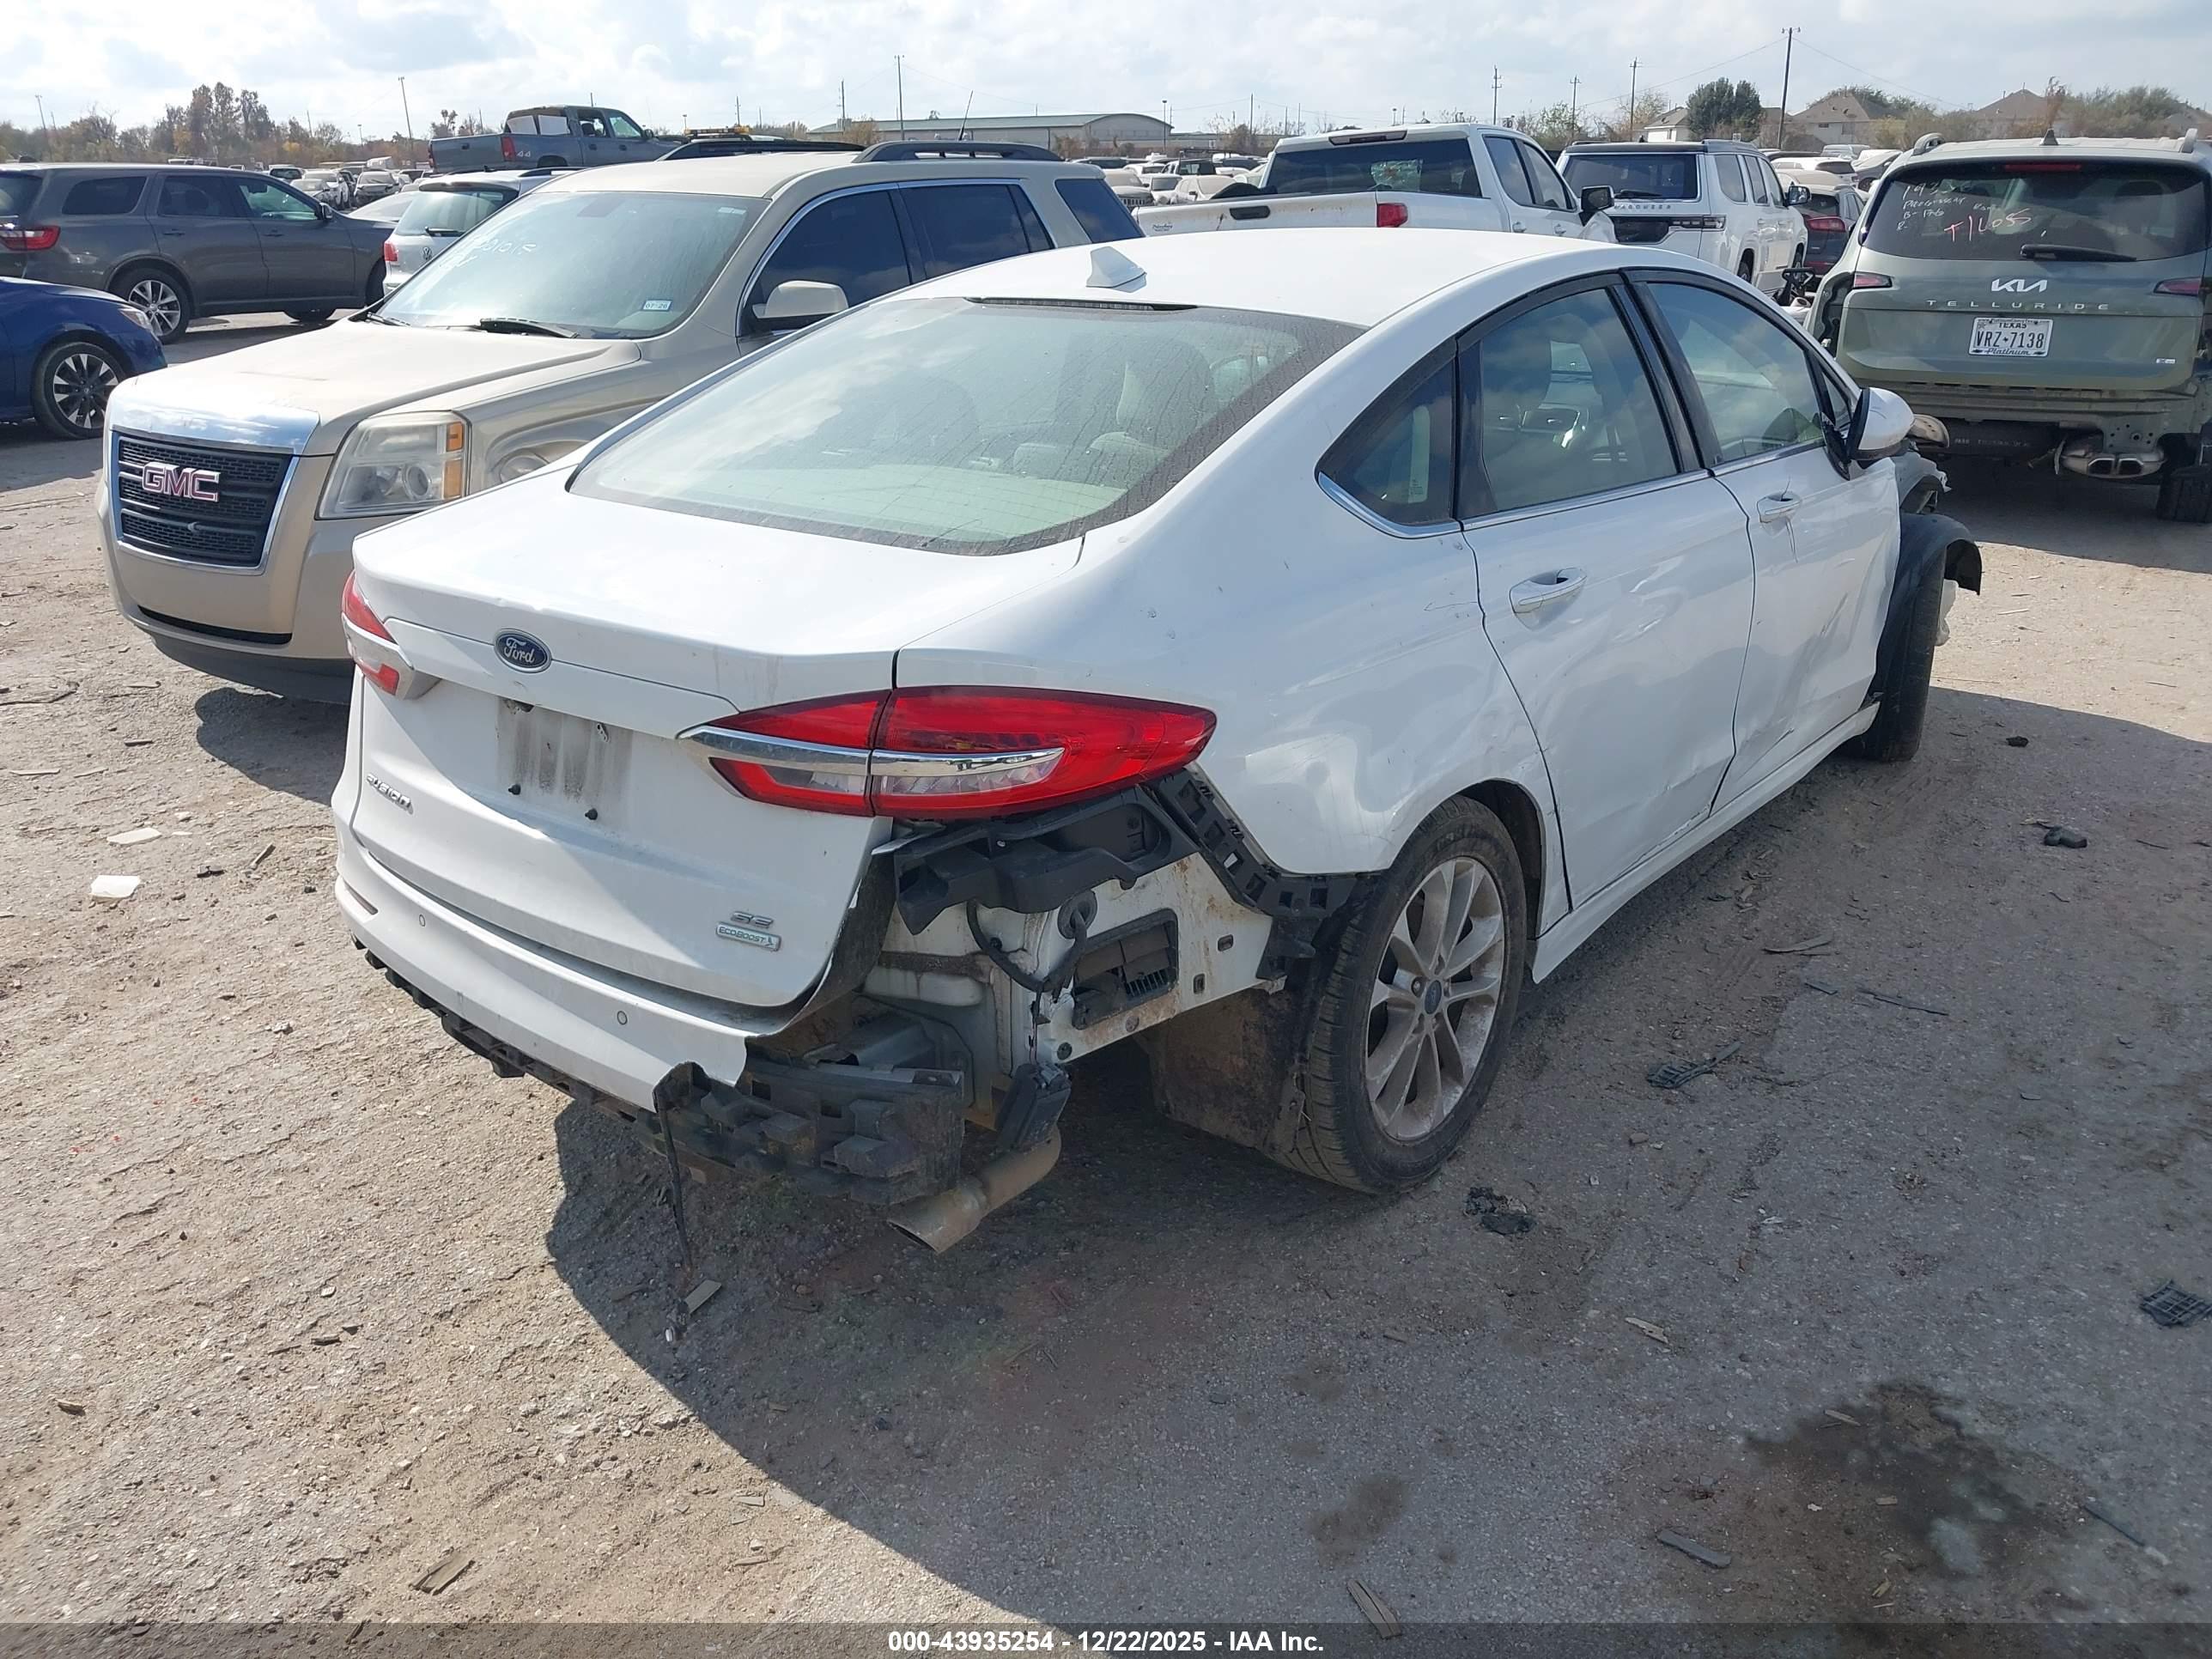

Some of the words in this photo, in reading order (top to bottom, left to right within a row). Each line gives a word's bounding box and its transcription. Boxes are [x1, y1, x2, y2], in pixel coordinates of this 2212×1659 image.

[1991, 278, 2048, 293] KIA
[1927, 300, 2110, 310] TELLURIDE
[143, 462, 221, 502] GMC
[503, 637, 535, 663] Ford
[731, 911, 774, 928] SE
